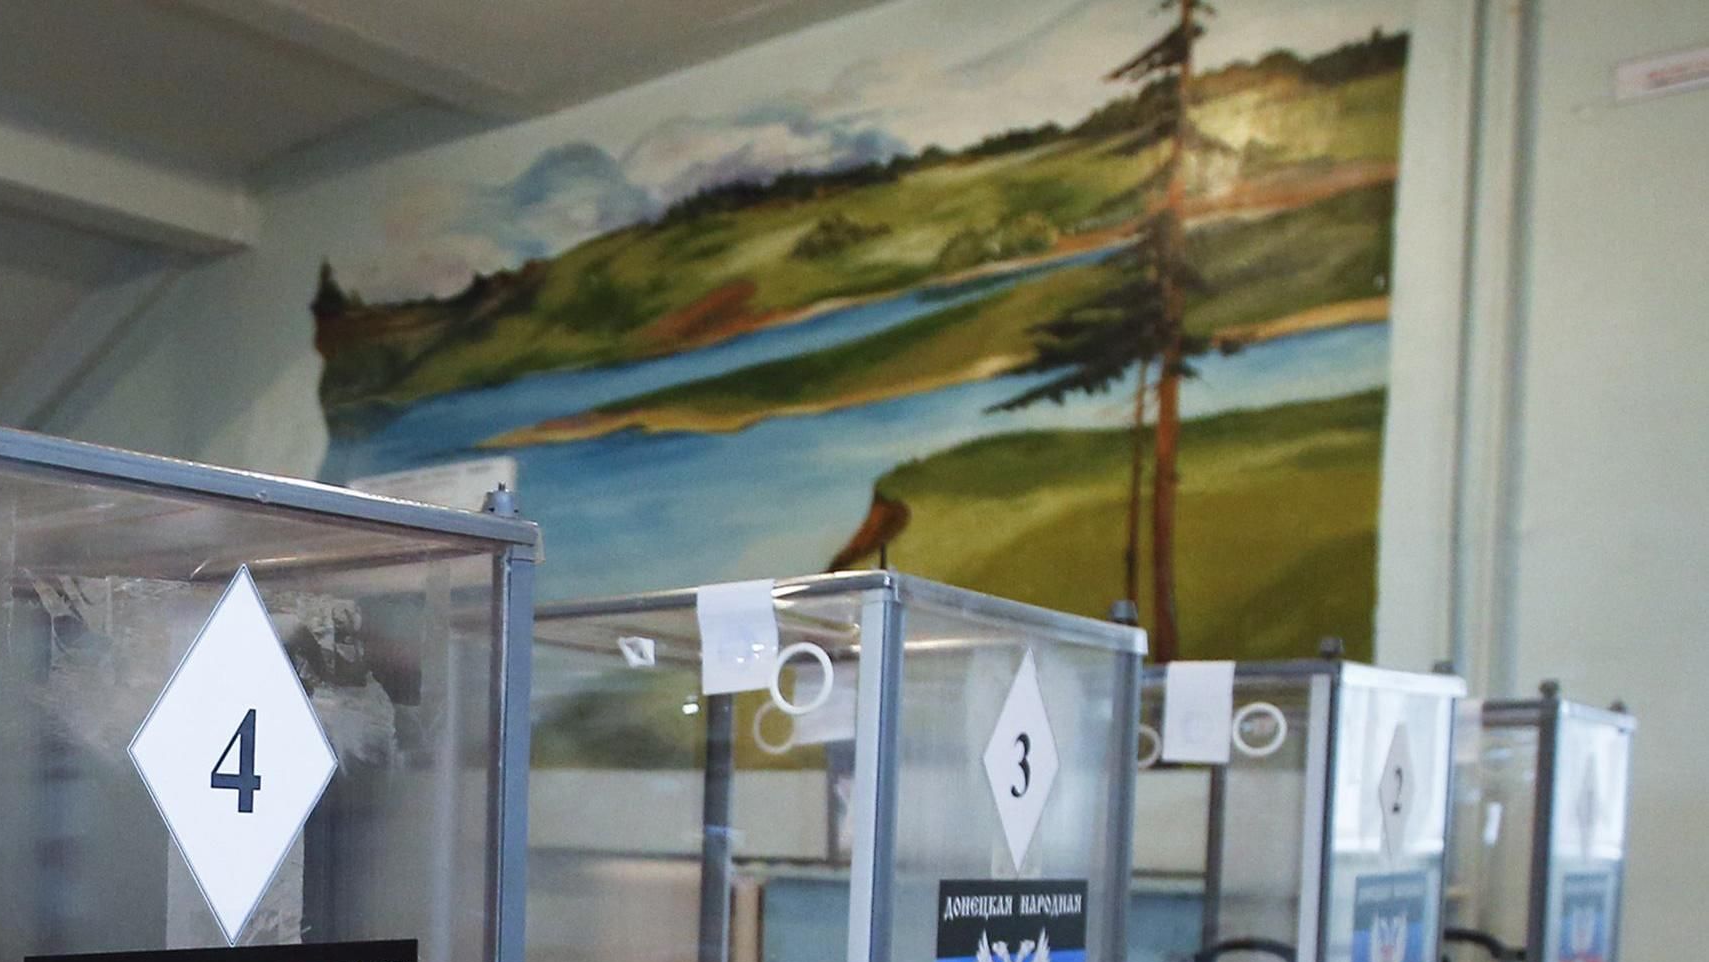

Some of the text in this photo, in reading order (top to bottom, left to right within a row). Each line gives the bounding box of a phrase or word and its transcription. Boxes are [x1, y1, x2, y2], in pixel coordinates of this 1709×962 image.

[210, 708, 262, 814] 4
[1009, 732, 1032, 799] 3
[943, 893, 1083, 921] ДОНЕЦКАЯ НАРОДНАЯ
